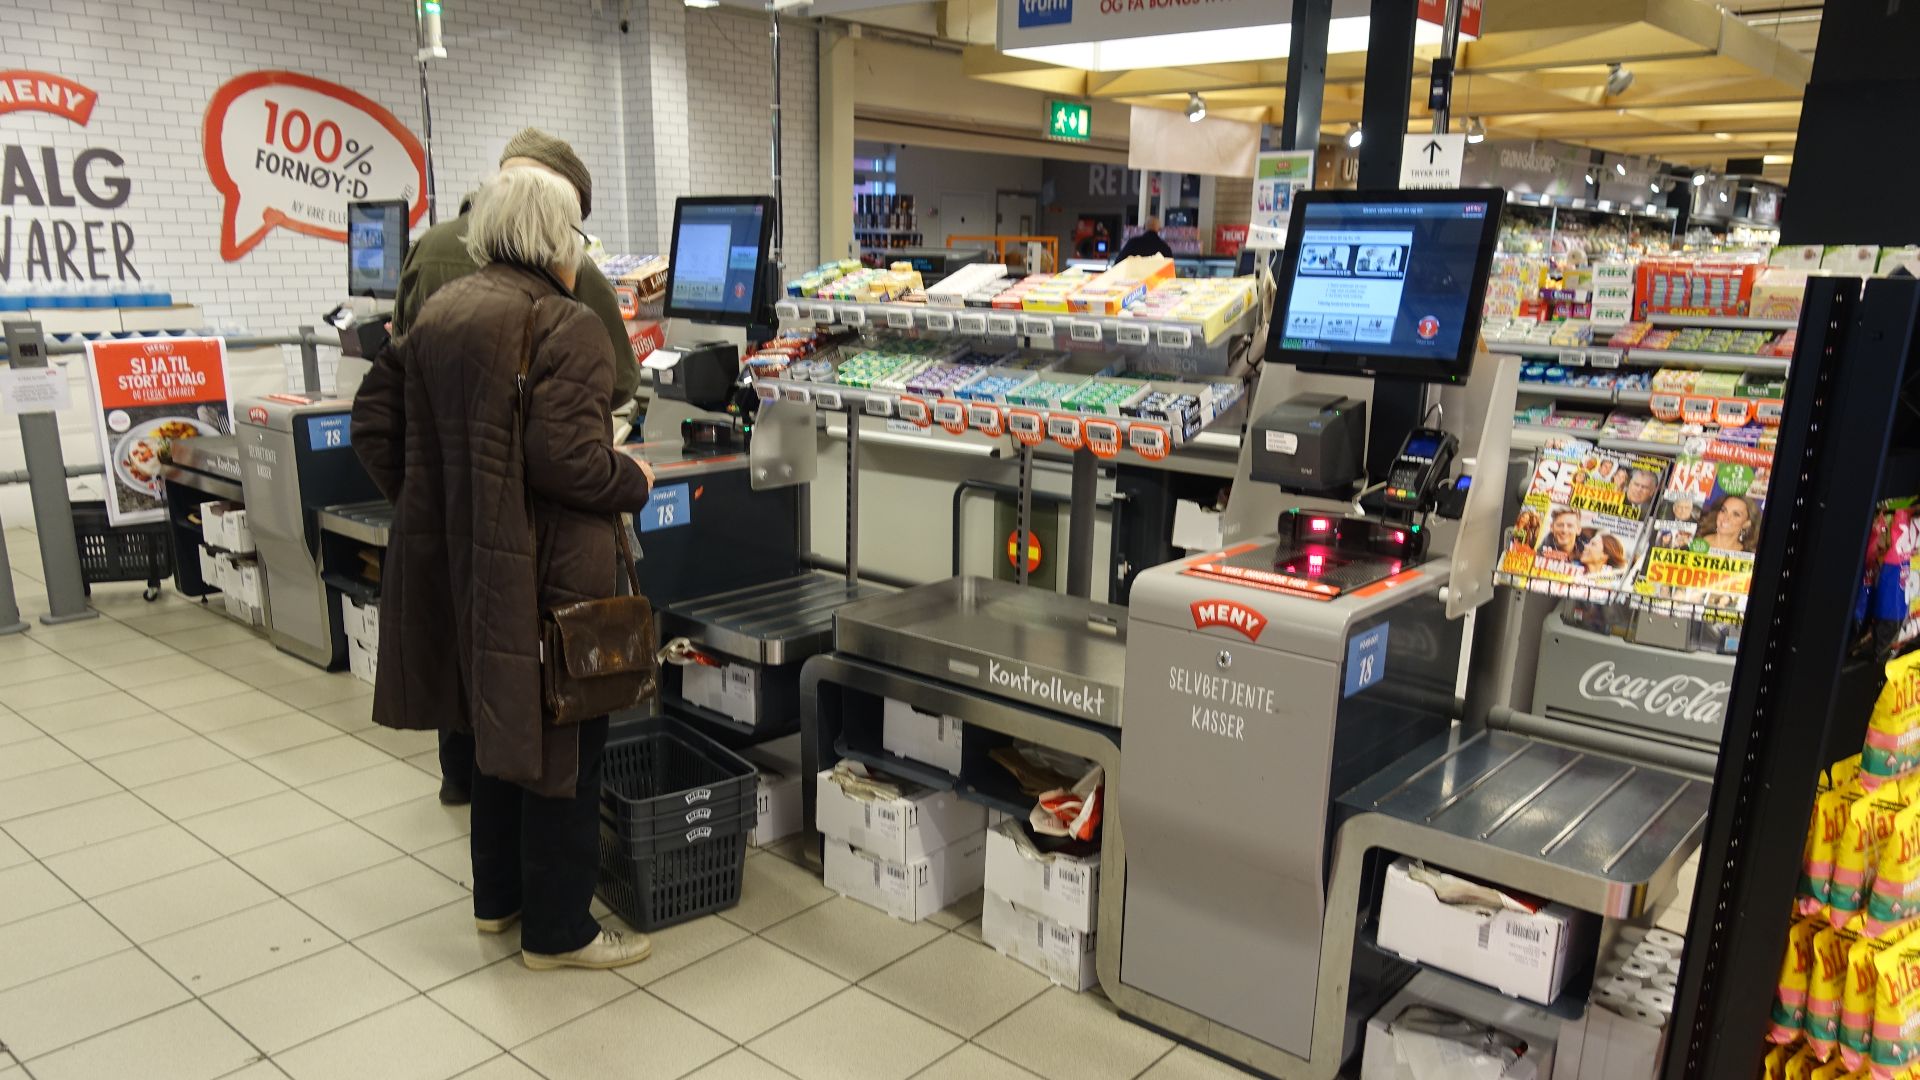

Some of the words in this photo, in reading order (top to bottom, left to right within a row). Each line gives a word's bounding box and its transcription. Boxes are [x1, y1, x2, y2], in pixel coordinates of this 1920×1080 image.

[1100, 0, 1122, 14] OG
[264, 99, 374, 175] 100%
[255, 148, 368, 199] FORNØY:D
[1411, 168, 1433, 178] TRYKK
[1435, 168, 1450, 177] HER
[291, 200, 303, 212] NY
[306, 206, 326, 219] VARE
[130, 358, 146, 375] SI
[150, 357, 168, 374] JA
[168, 355, 190, 373] TIL
[118, 374, 159, 391] STORT
[161, 371, 206, 389] UTVALG
[1571, 495, 1588, 510] AV
[1588, 498, 1640, 521] FAMILIEN
[1653, 550, 1689, 566] KATE
[1198, 604, 1260, 632] MENY
[989, 658, 1105, 717] Kontrollvekt
[1169, 665, 1275, 715] SELVBETJENTE
[1578, 660, 1731, 725] Coca-Cola
[1191, 703, 1245, 742] KASSER
